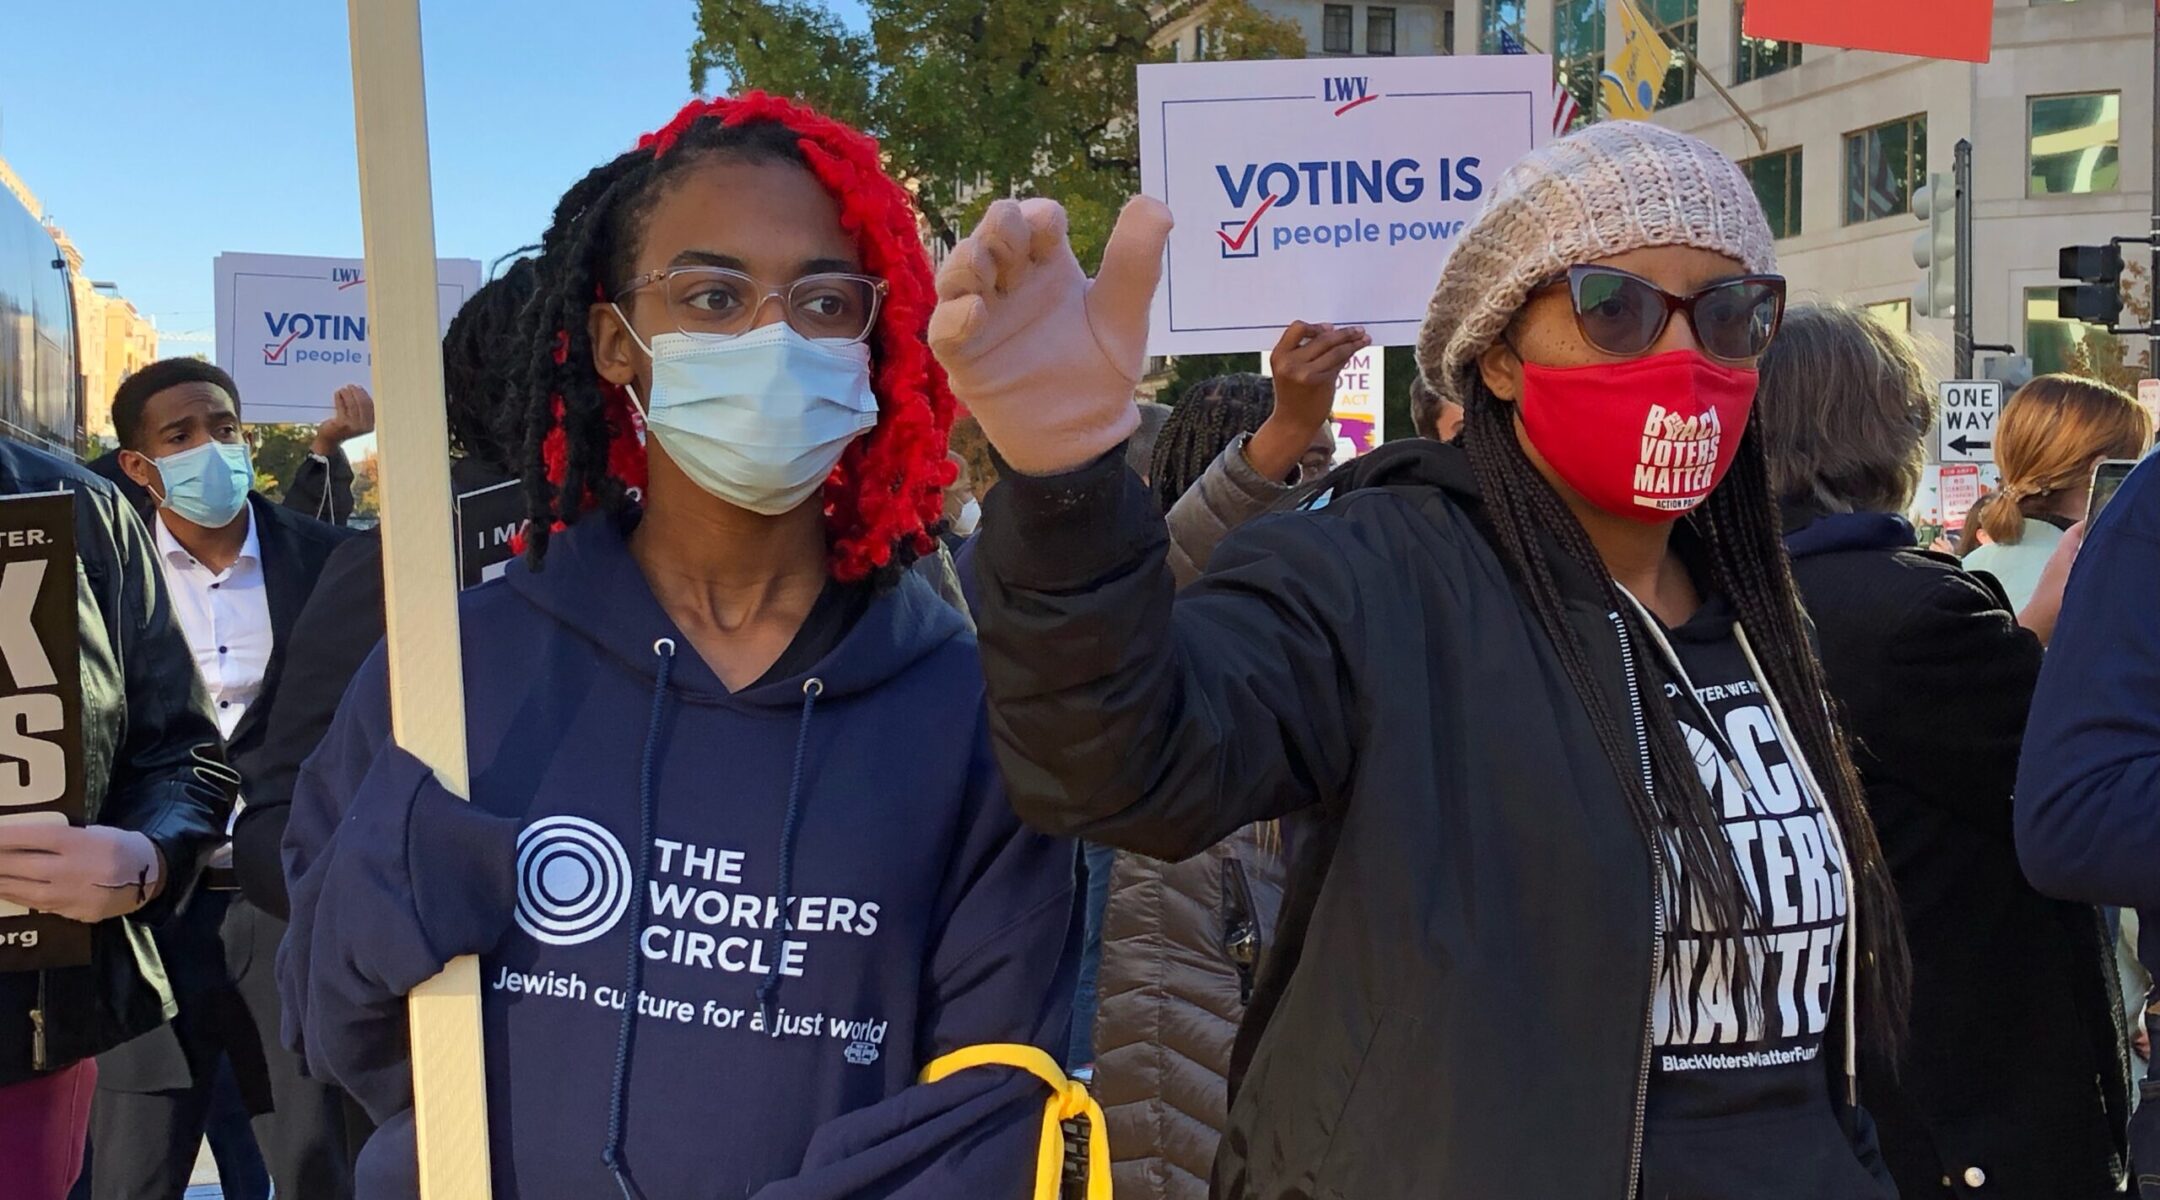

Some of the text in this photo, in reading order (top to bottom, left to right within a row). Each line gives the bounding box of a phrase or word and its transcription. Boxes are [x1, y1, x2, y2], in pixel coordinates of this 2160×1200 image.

[1323, 76, 1369, 102] LWV
[1215, 156, 1483, 208] VOTING IS
[1273, 218, 1379, 250] people
[332, 268, 361, 283] LWV
[264, 311, 372, 342] VOTIN
[296, 348, 362, 365] people
[1342, 394, 1368, 406] ACT
[1947, 388, 1993, 407] ONE
[1946, 411, 1995, 430] WAY
[1640, 434, 1720, 468] VOTERS
[1633, 462, 1716, 494] MATTER
[478, 531, 485, 550] I
[654, 838, 746, 884] THE
[648, 879, 881, 937] WORKERS
[640, 925, 809, 978] CIRCLE
[492, 966, 587, 1001] Jewish
[594, 988, 694, 1023] cuture
[702, 1000, 746, 1029] for
[771, 1007, 825, 1038] just
[830, 1017, 888, 1044] world
[1661, 1043, 1820, 1072] BlackVotersMatterFun
